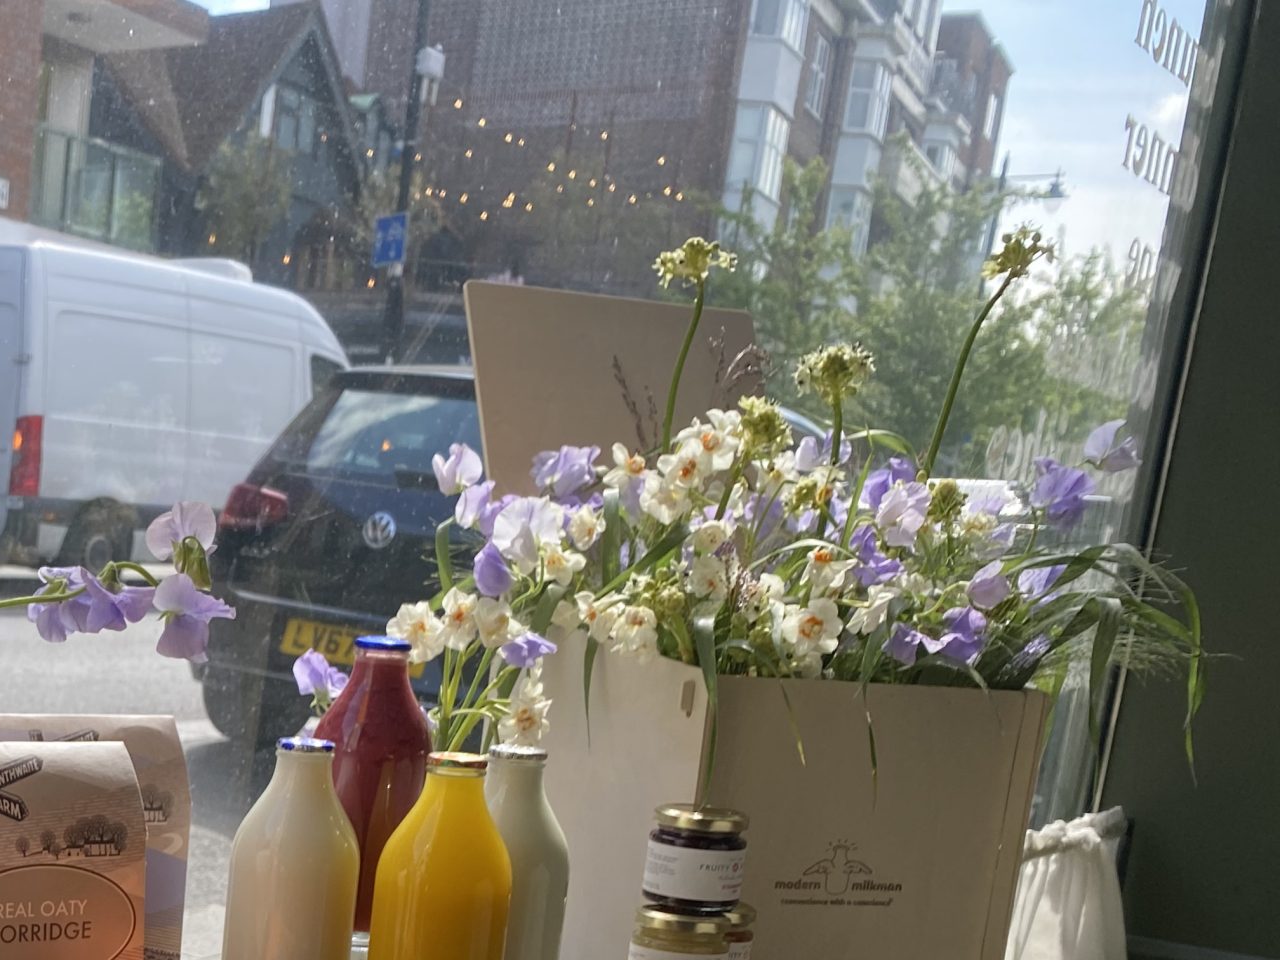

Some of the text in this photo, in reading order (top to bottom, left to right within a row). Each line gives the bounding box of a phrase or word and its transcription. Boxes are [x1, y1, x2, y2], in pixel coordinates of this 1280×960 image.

[699, 862, 731, 872] FRUITY
[774, 878, 903, 892] modern milkman
[40, 899, 88, 918] OATY
